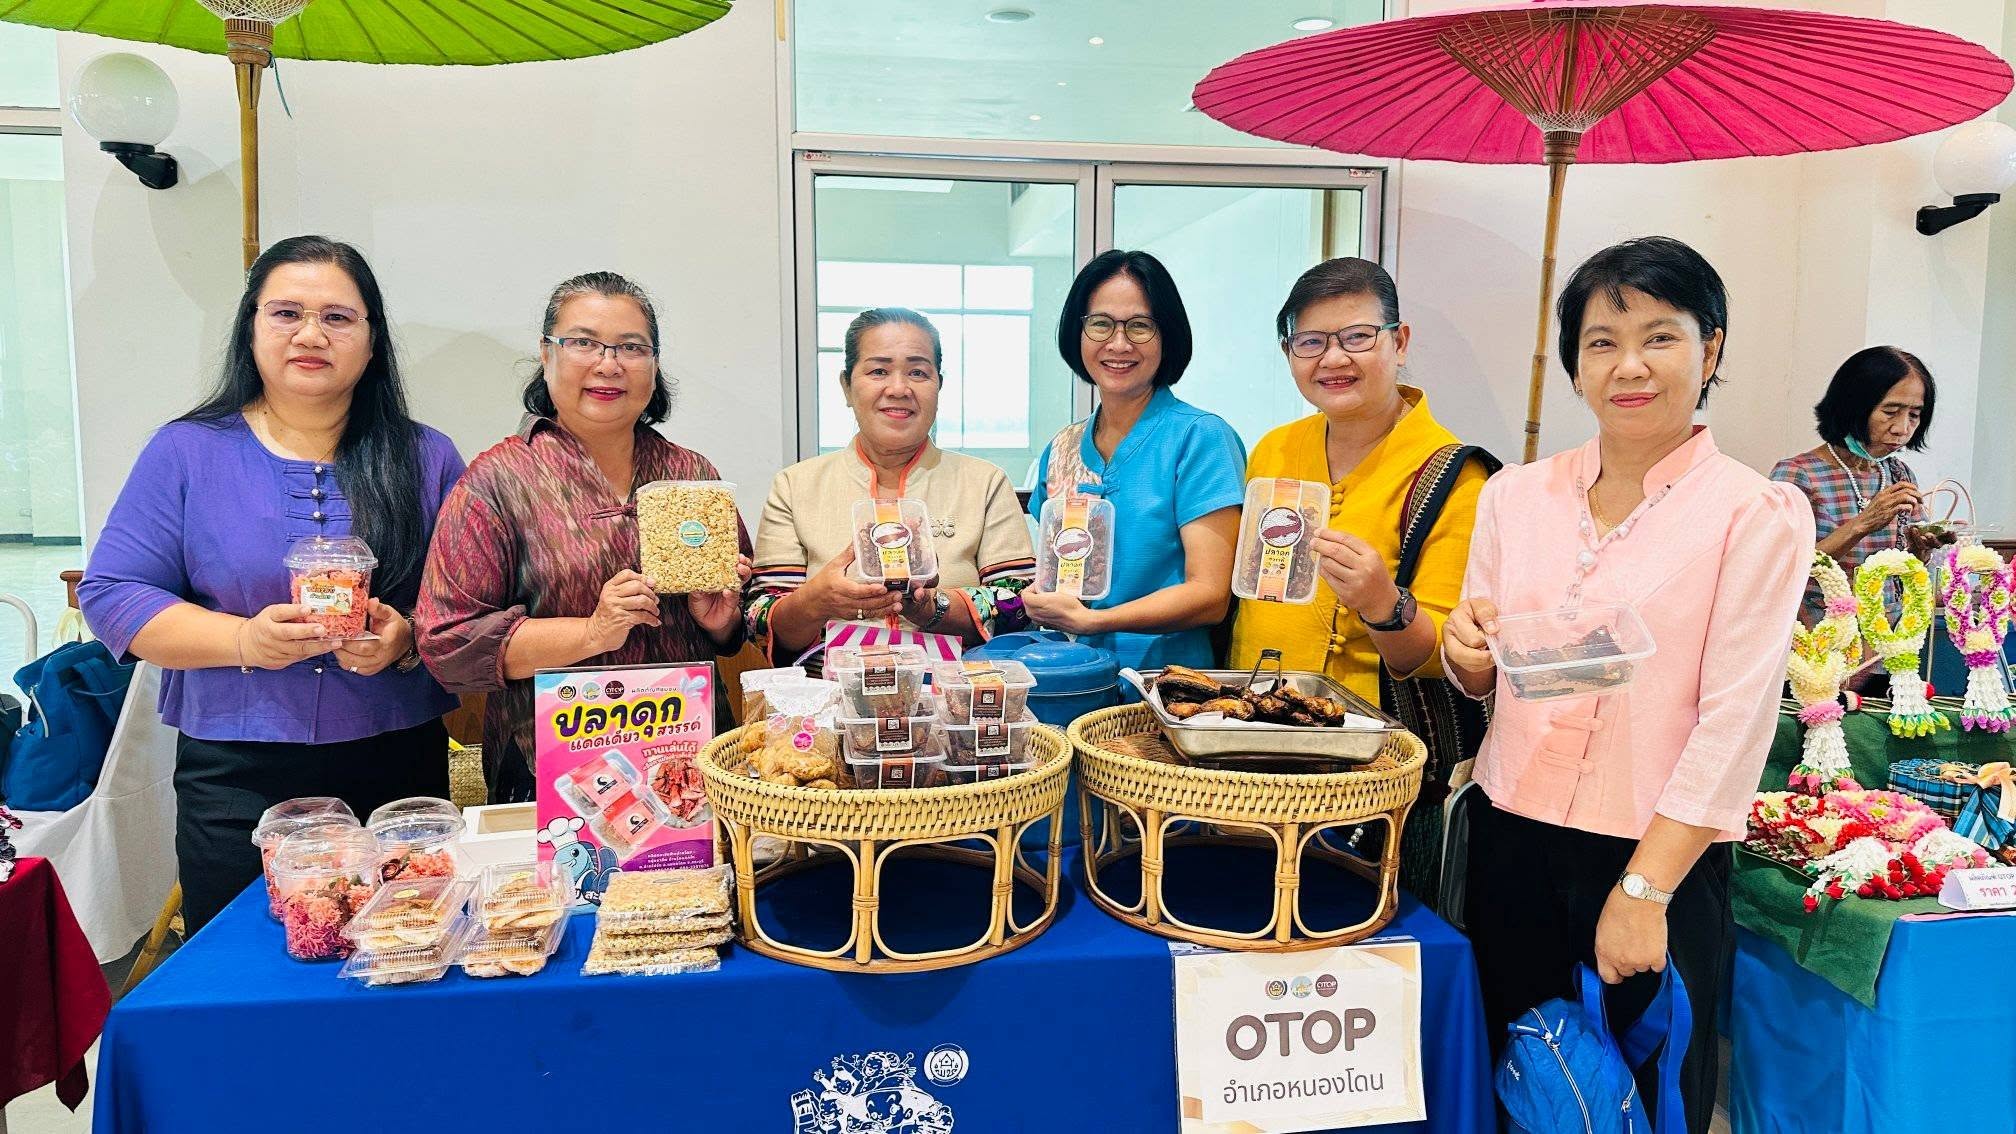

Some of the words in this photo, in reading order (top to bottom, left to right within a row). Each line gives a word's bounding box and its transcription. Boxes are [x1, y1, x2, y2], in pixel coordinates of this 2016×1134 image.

[556, 696, 681, 738] ปลาดุก
[570, 730, 640, 751] แดดเดียว
[657, 716, 701, 736] สวรรค์
[642, 741, 698, 757] ทานเล่นได้
[1979, 887, 2007, 897] ราคา
[1226, 1008, 1376, 1061] OTOP
[1224, 1068, 1384, 1104] อำเภอหนองโดน
